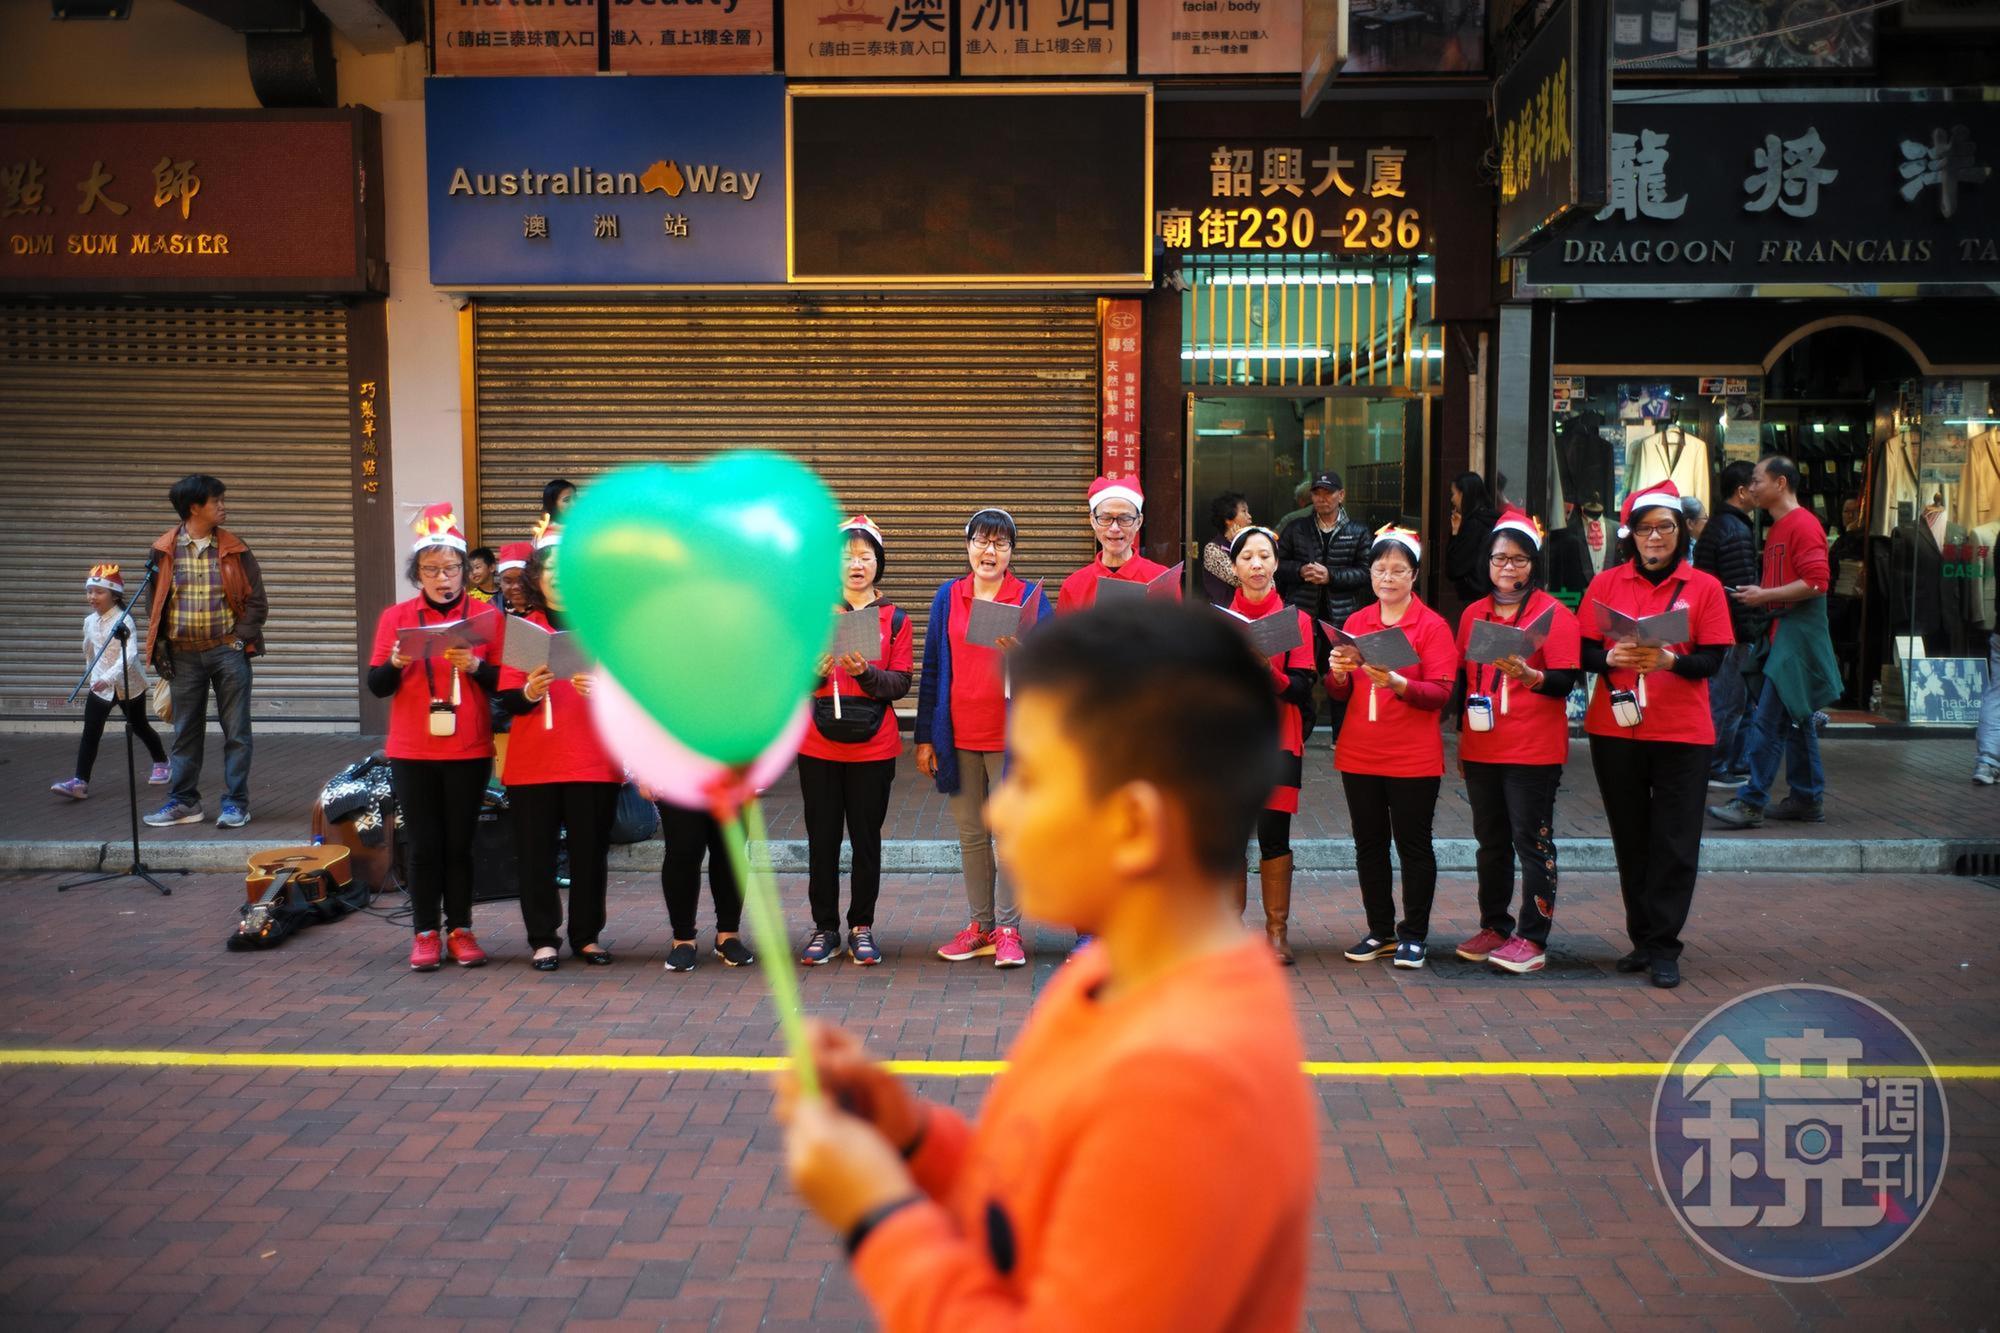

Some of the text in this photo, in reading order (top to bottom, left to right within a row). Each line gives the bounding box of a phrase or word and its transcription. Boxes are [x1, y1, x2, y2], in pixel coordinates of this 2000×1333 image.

[1183, 1, 1217, 12] facial
[1228, 1, 1260, 13] body
[449, 165, 761, 200] Australian Way
[1210, 146, 1407, 199] 韶興大廈
[523, 213, 688, 238] 澳洲站
[10, 234, 230, 255] DIM SUM MASTER
[1563, 240, 1734, 263] DRAGOON
[1757, 240, 1933, 263] FRANCAIS
[1728, 385, 1746, 393] VISA
